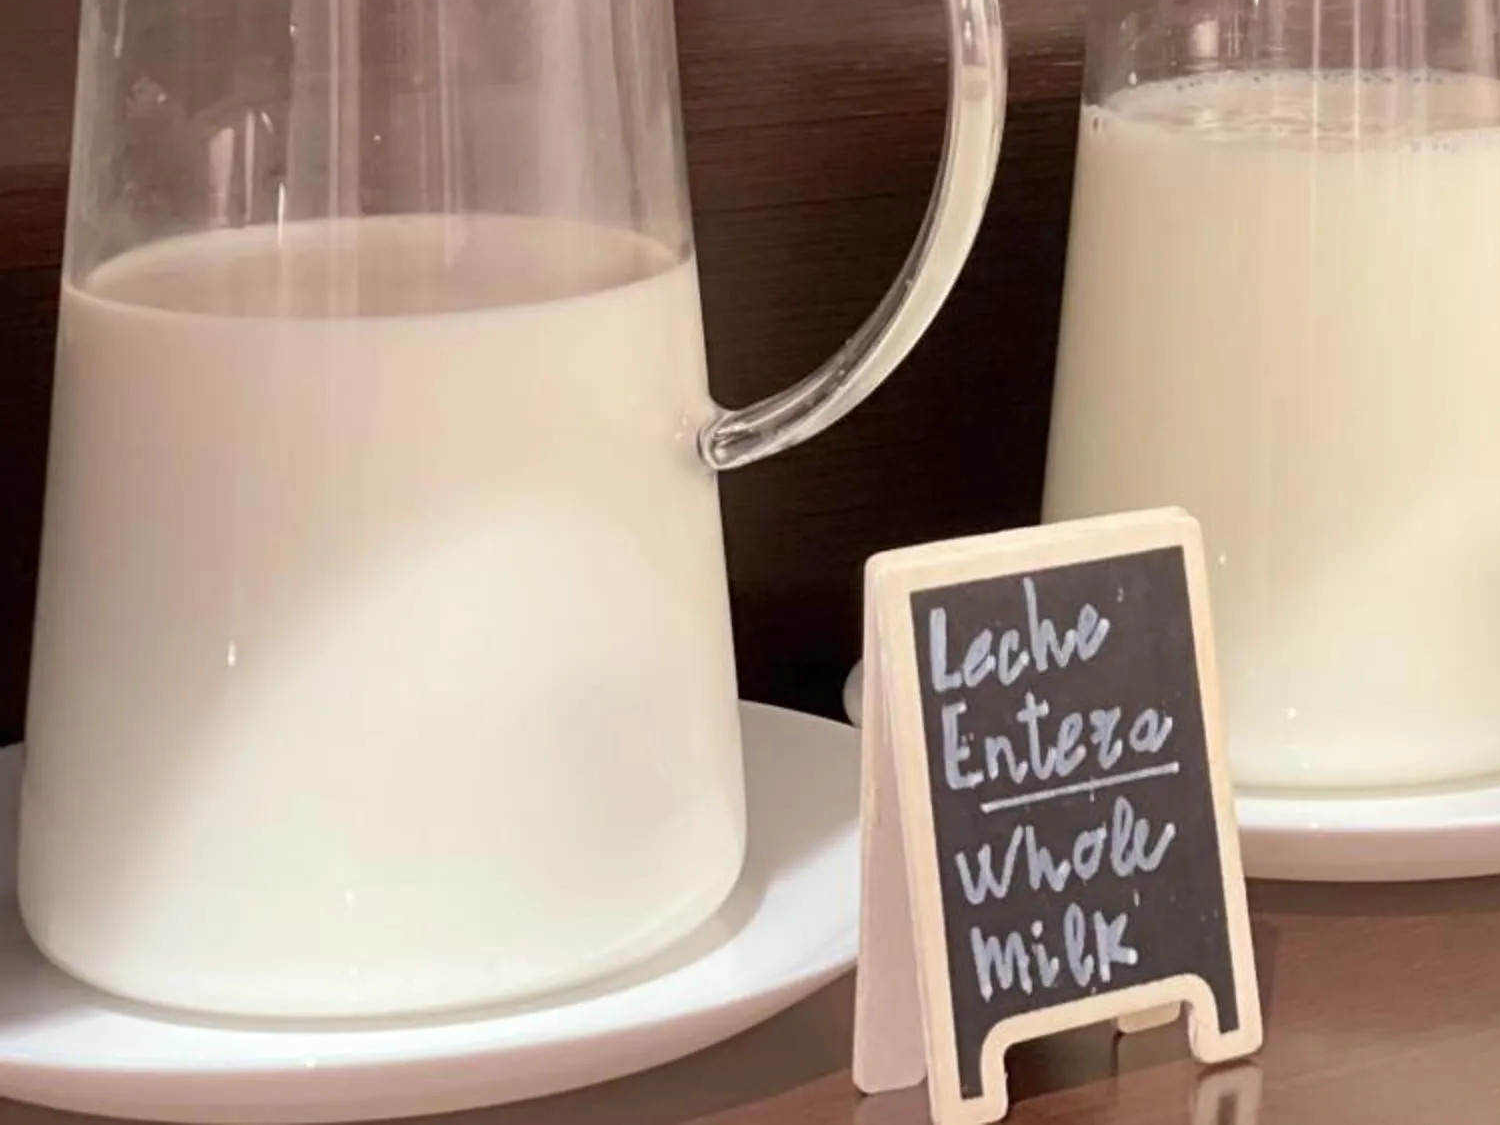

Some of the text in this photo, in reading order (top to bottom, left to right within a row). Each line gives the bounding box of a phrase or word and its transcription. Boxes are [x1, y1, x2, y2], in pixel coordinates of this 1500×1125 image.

[928, 577, 1110, 692] Leche
[941, 692, 1174, 789] Entera
[955, 796, 1176, 905] Whole
[970, 902, 1138, 1002] Milk
